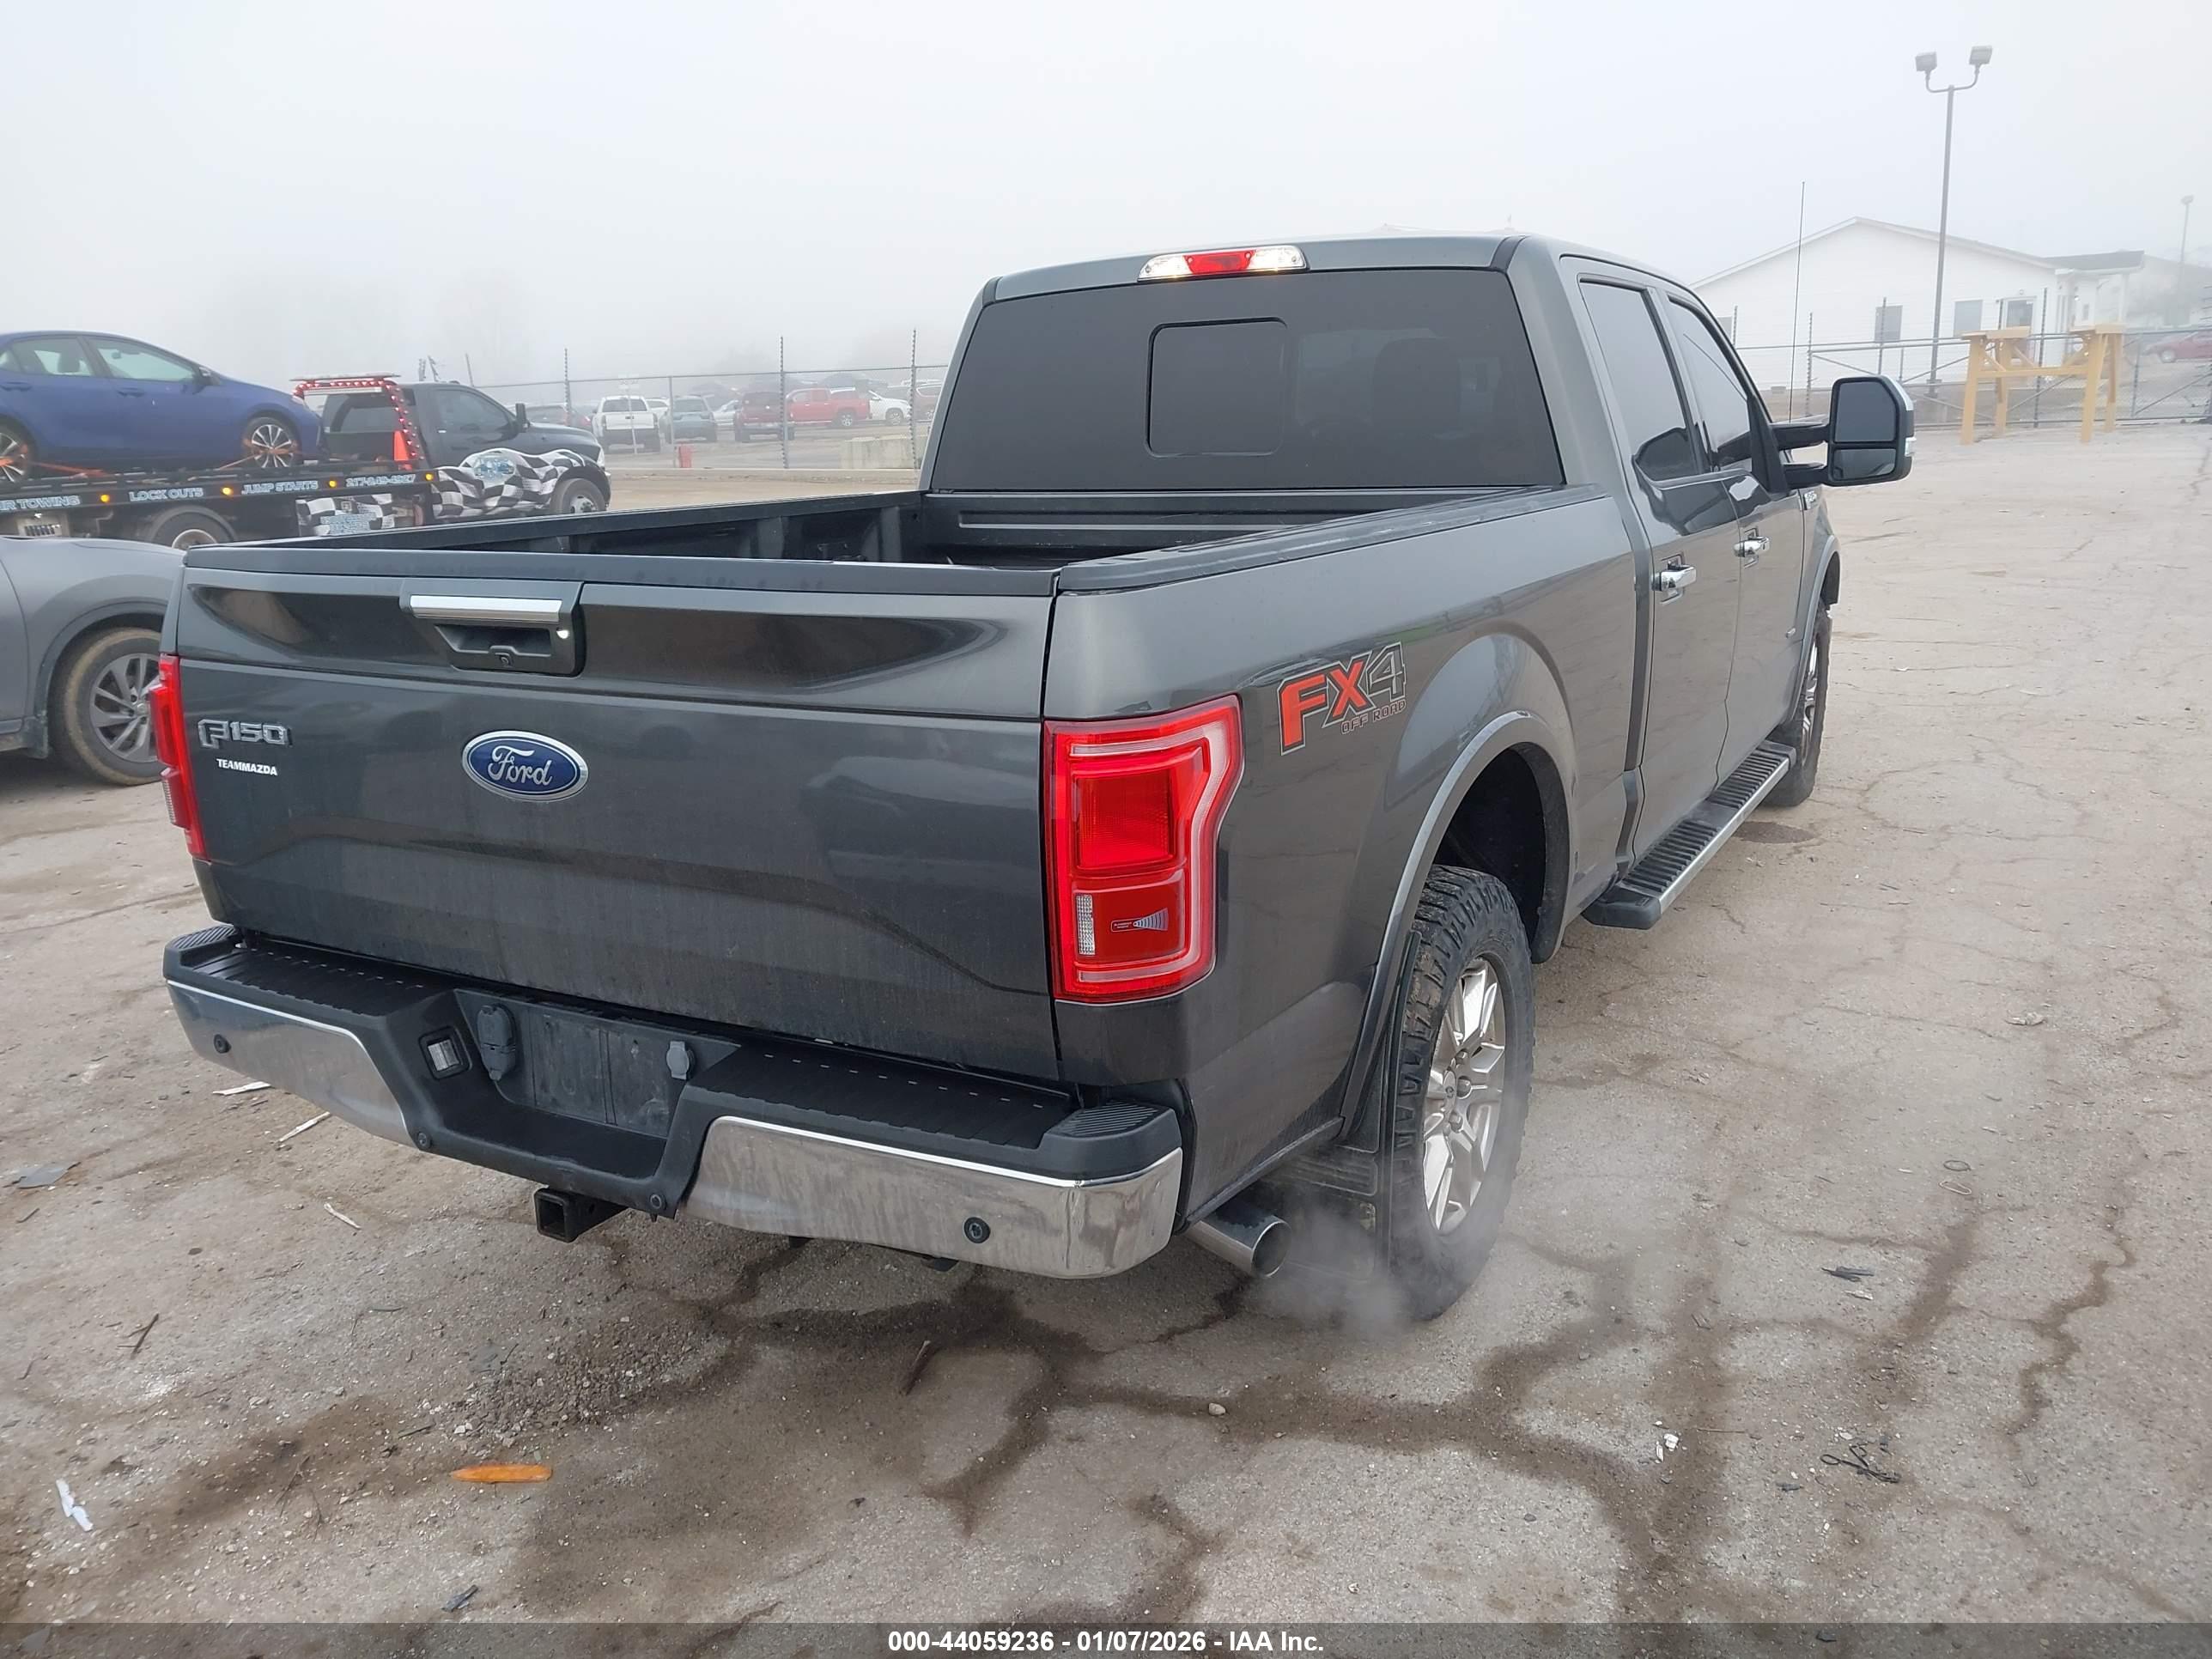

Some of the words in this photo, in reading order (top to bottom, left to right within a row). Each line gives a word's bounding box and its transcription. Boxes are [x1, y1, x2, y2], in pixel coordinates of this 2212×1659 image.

[129, 490, 168, 502] LOCK
[170, 487, 204, 500] OUTS
[241, 483, 274, 495] JUMP
[275, 480, 318, 492] STARTS
[16, 495, 81, 509] TOWING
[1278, 641, 1407, 756] FX4
[1340, 714, 1369, 735] OFF
[1373, 699, 1407, 722] ROAD
[216, 757, 278, 776] TEAMMAZDA
[488, 745, 553, 786] Ford
